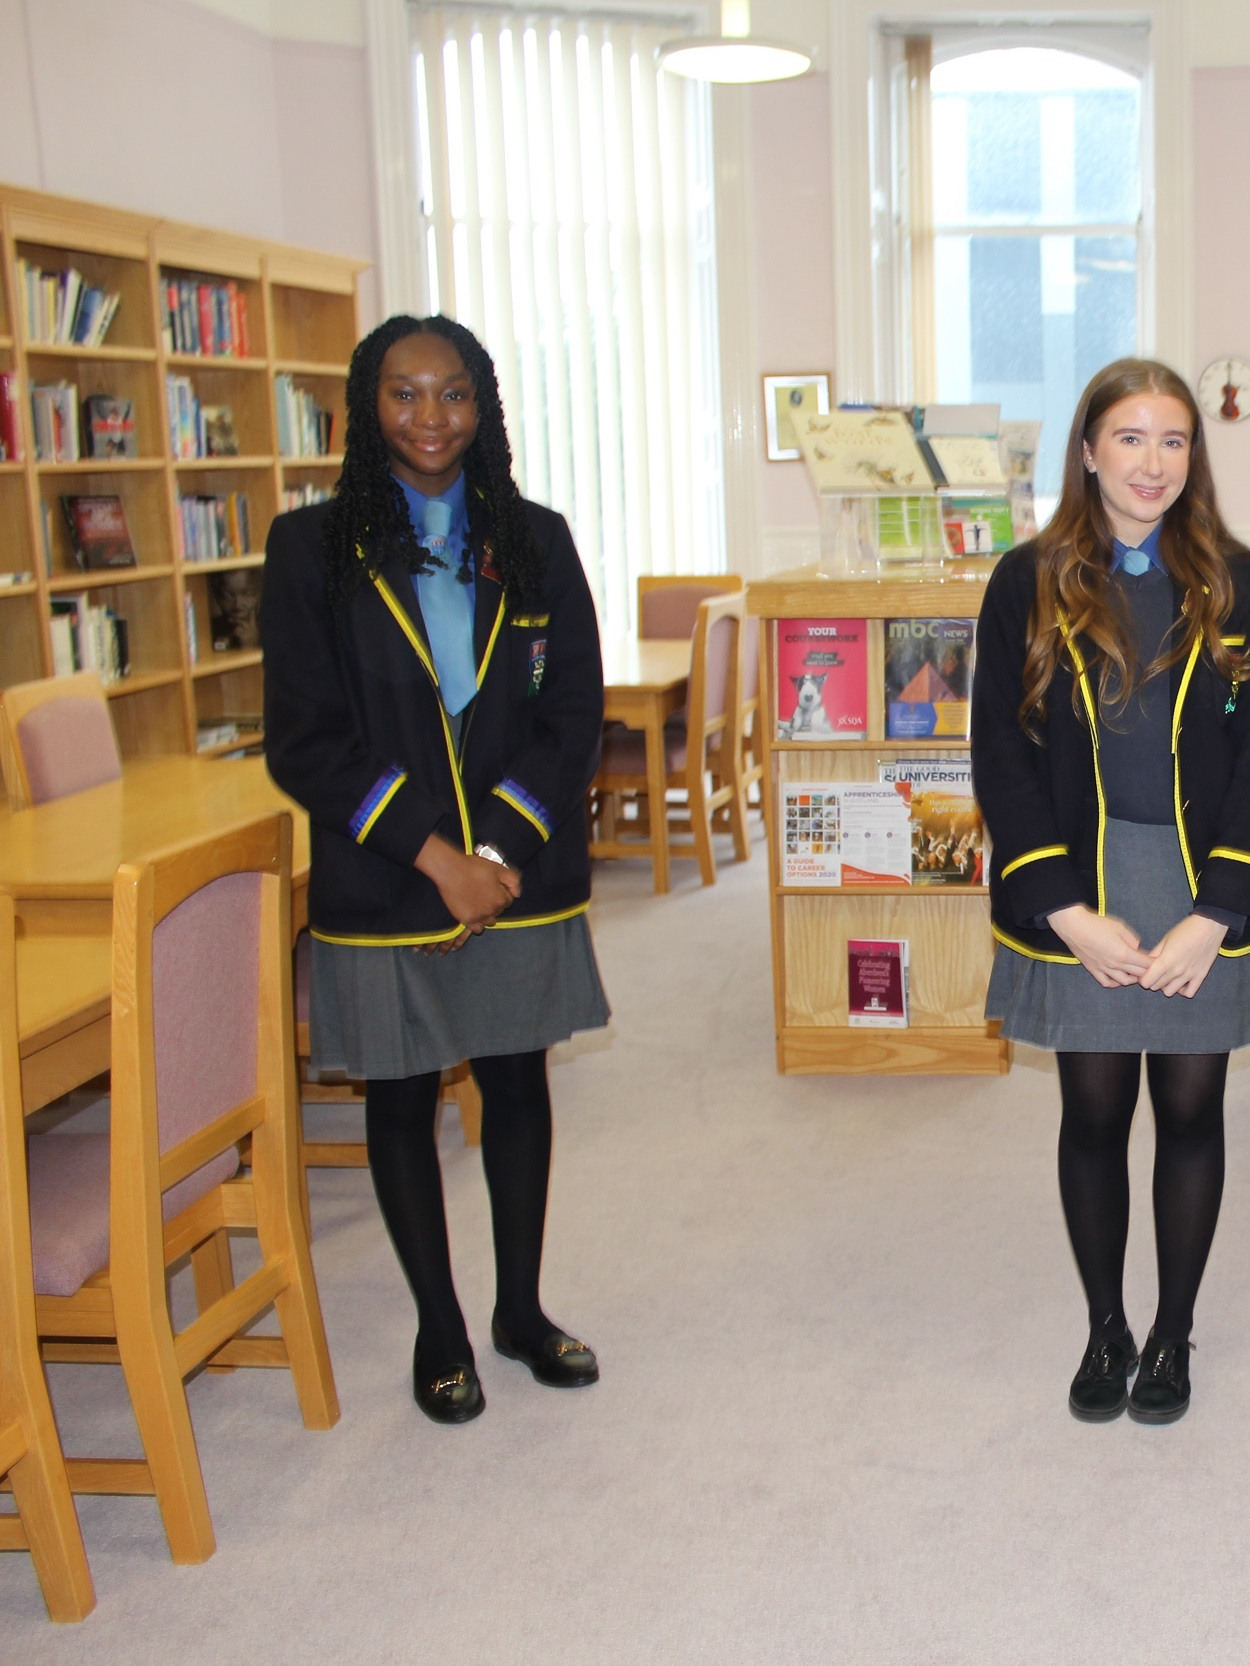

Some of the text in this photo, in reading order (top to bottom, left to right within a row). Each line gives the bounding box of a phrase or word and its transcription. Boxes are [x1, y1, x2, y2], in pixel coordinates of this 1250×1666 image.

[808, 627, 836, 636] YOUR
[889, 619, 968, 639] mbc NEWS
[785, 635, 858, 643] COURSEWORK
[846, 717, 863, 726] SQA
[899, 772, 972, 782] UNIVERSITI
[858, 960, 890, 970] Celebrating
[859, 976, 890, 987] Pioneering
[863, 984, 886, 993] Women
